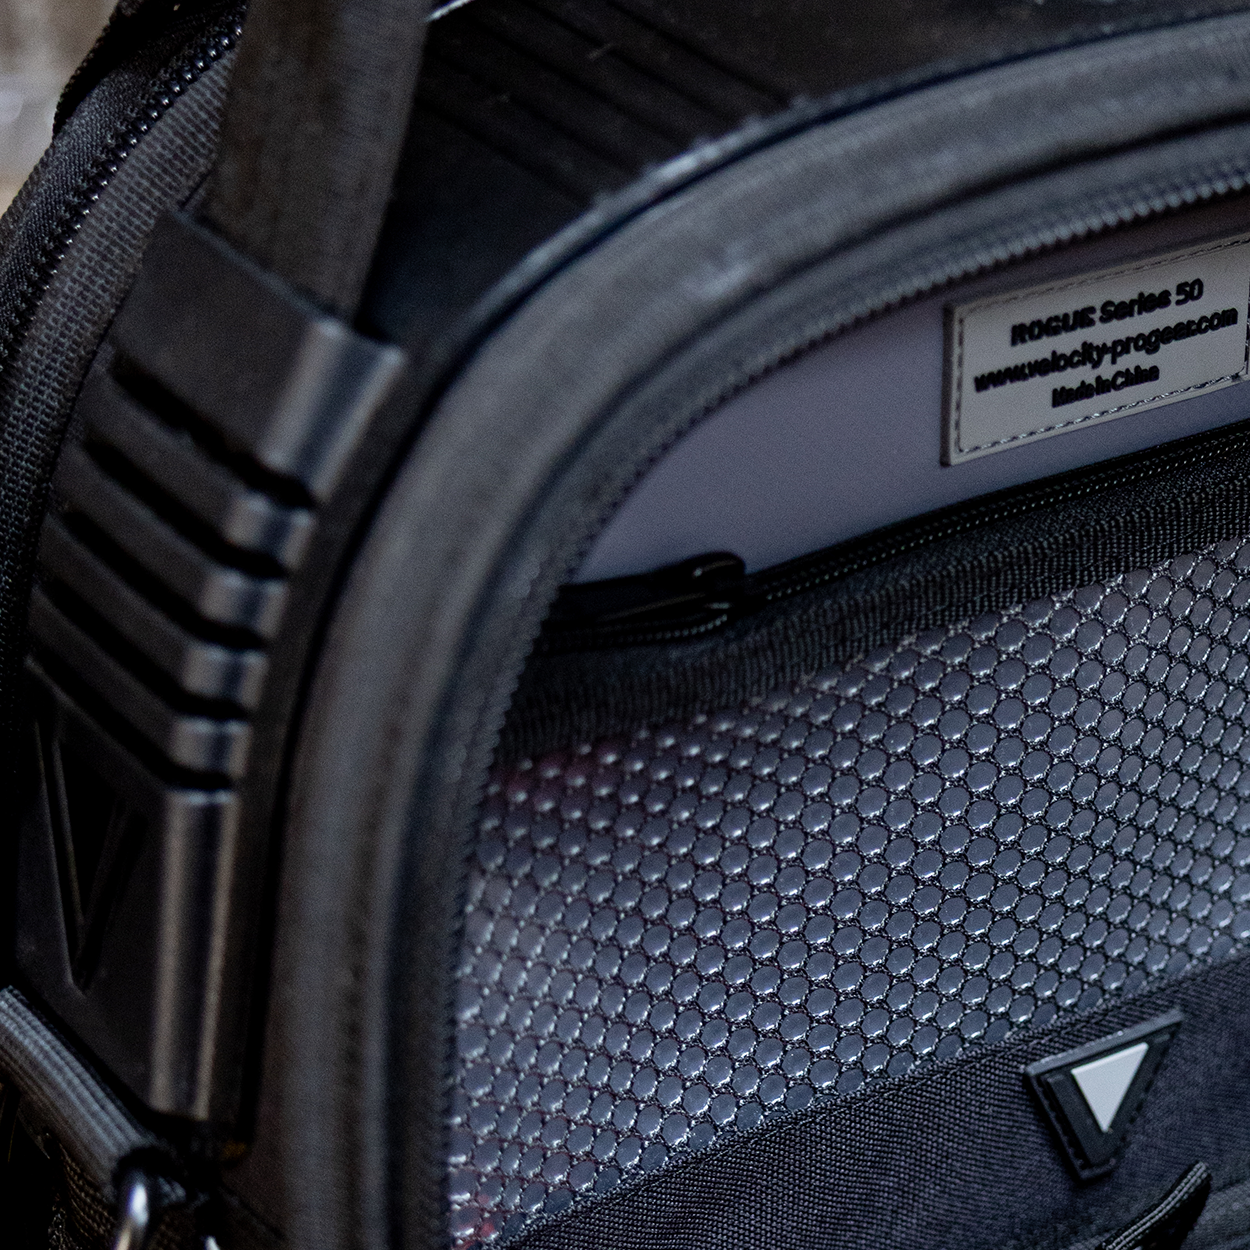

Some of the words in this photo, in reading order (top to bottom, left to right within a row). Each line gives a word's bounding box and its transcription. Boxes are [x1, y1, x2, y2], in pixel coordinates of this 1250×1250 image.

[1010, 306, 1097, 347] ROGUE
[1099, 289, 1172, 324] Series
[1174, 278, 1205, 306] 50
[1112, 364, 1161, 392] China
